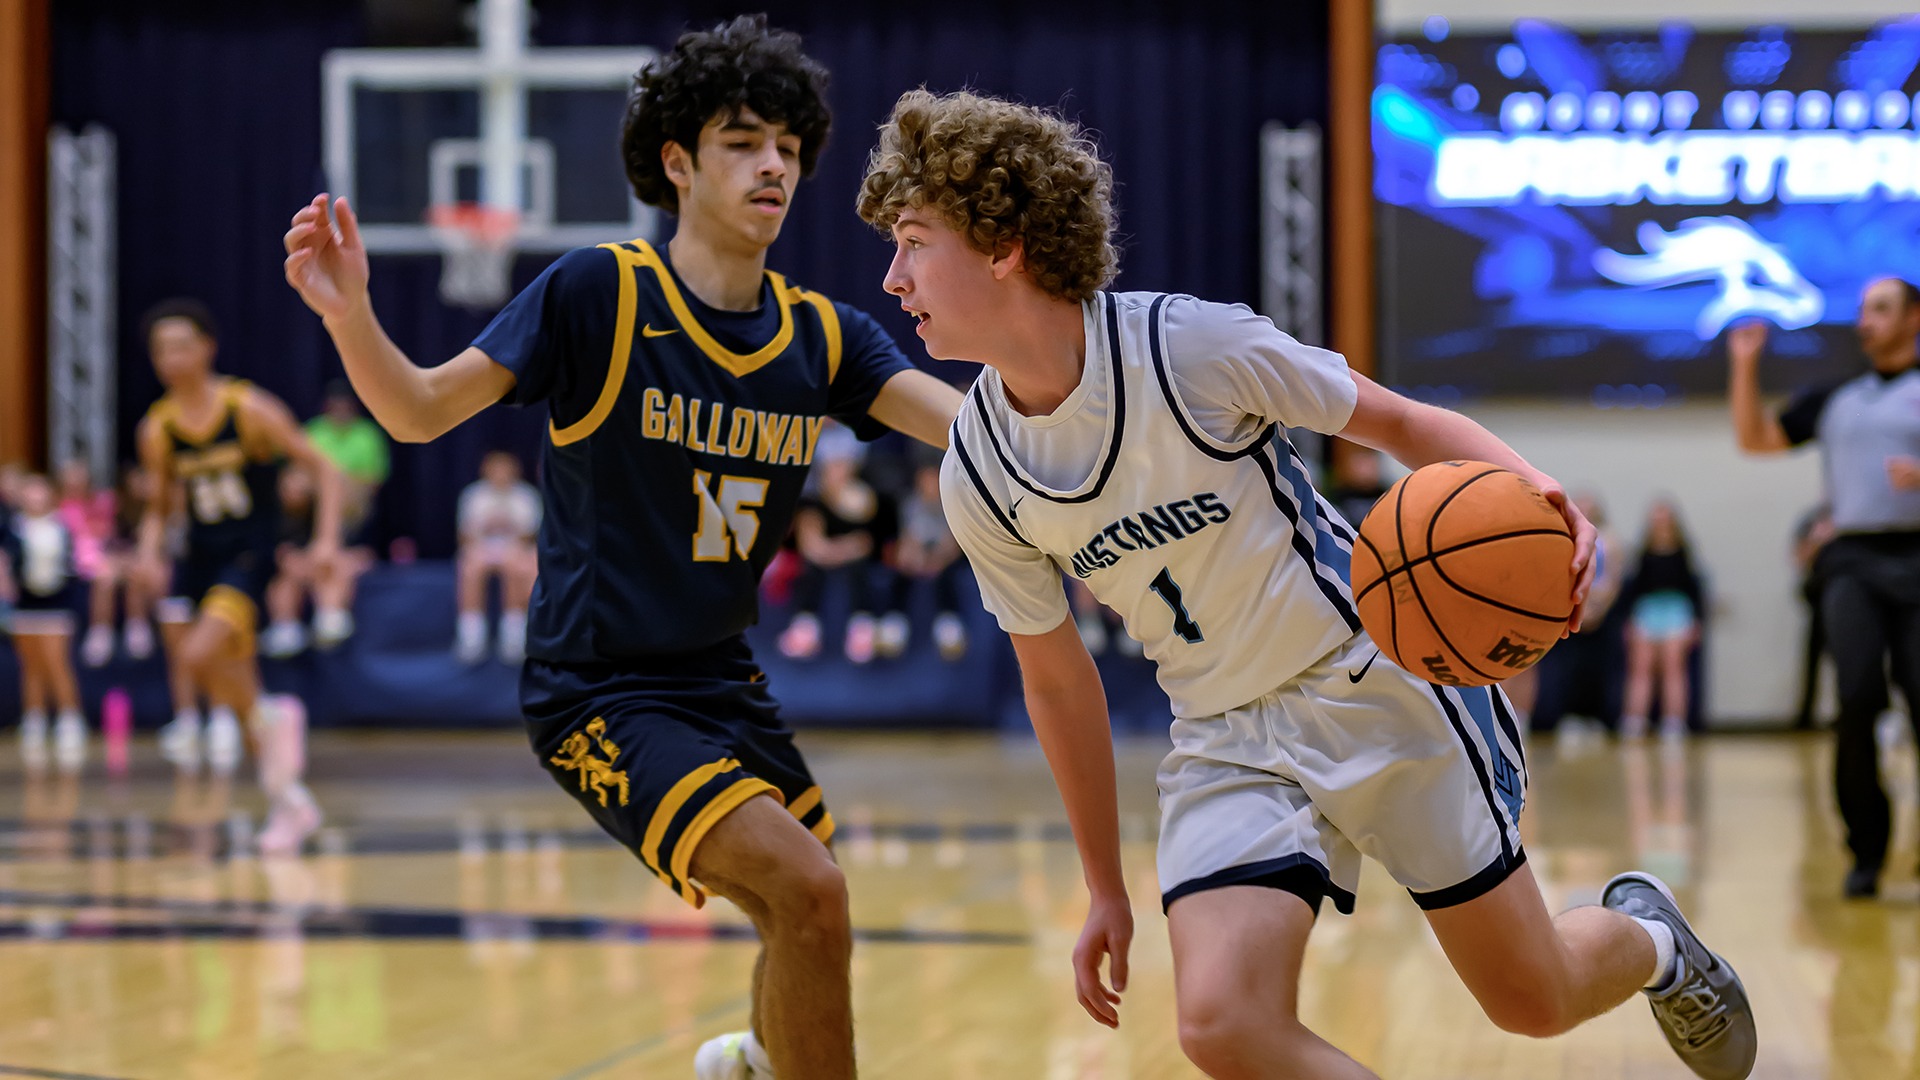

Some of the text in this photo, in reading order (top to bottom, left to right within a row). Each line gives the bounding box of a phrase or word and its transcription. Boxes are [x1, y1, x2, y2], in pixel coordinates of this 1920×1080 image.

[642, 387, 826, 466] GALLOWAY
[692, 467, 770, 562] 15
[1148, 565, 1205, 645] 1
[1486, 636, 1545, 669] CAA
